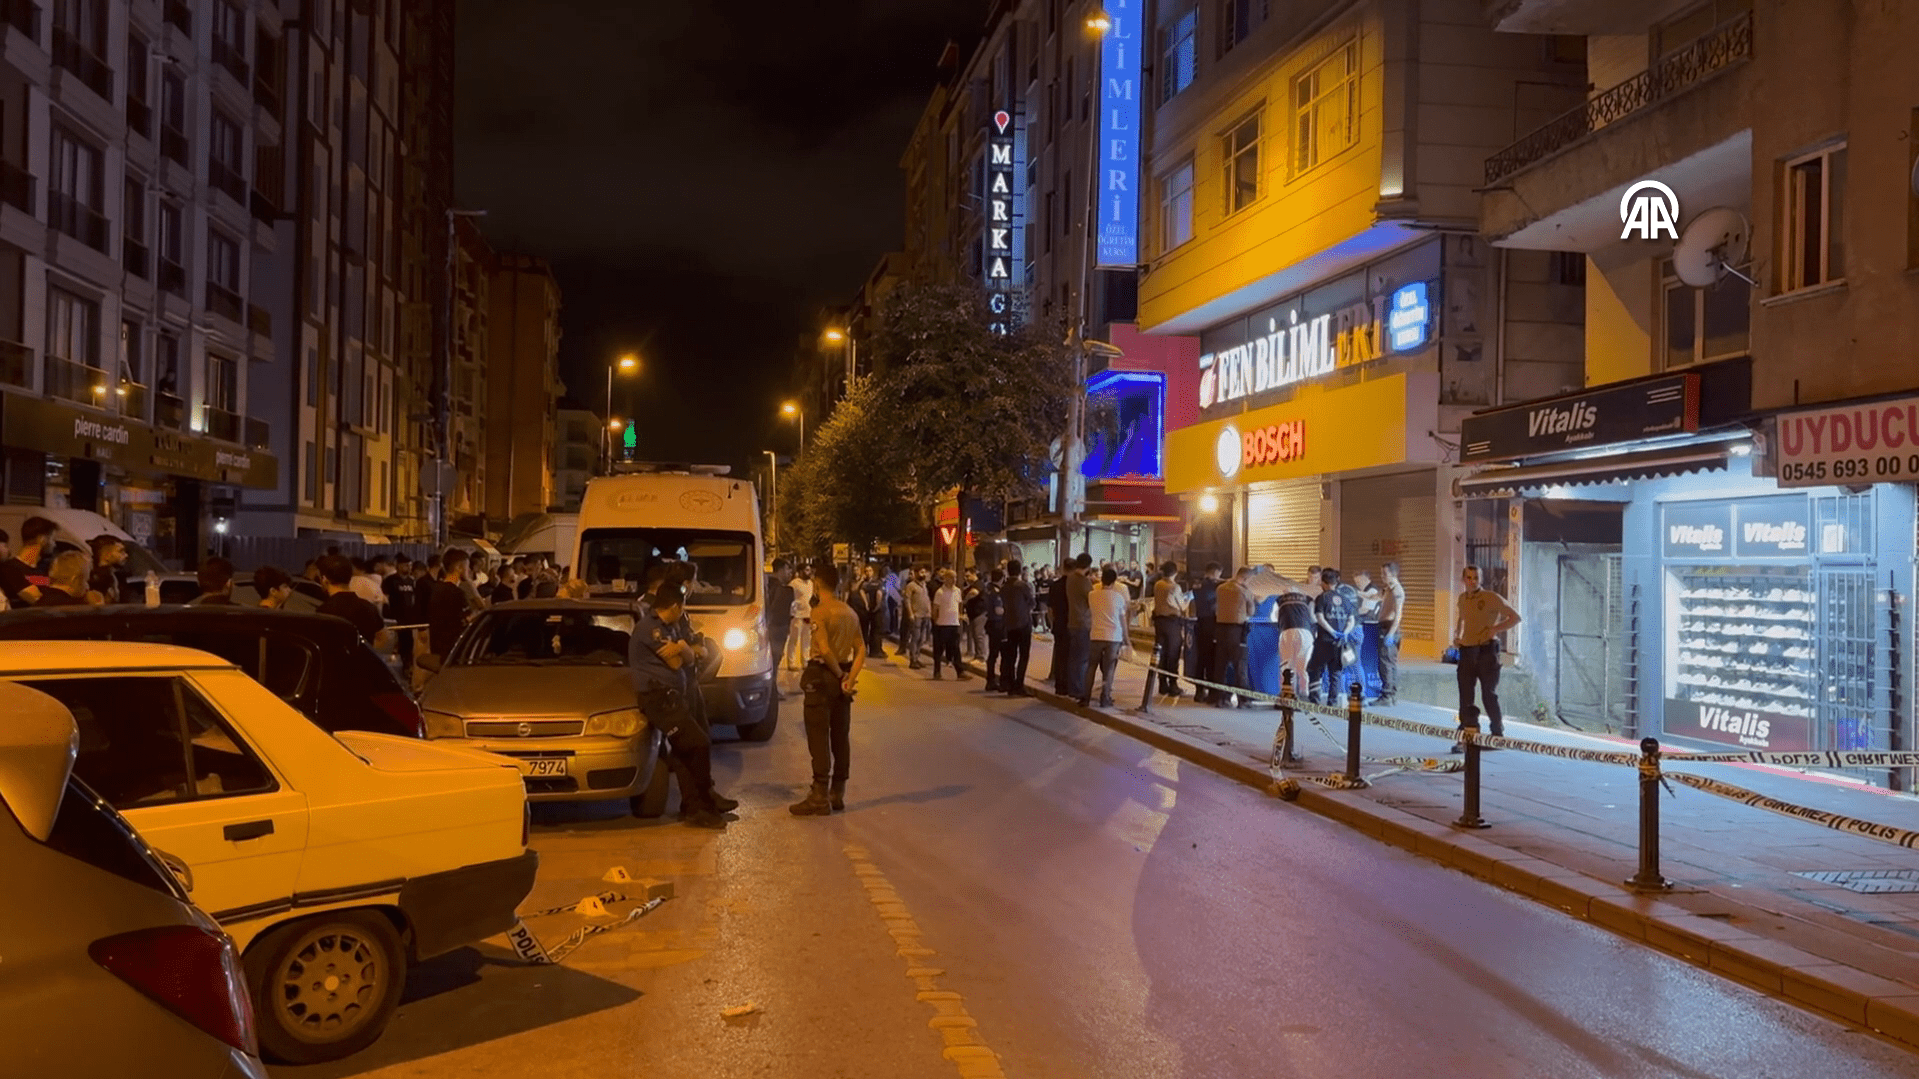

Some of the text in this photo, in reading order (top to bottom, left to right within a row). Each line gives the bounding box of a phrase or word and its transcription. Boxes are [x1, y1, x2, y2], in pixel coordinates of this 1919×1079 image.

[991, 144, 1011, 278] MARKA
[1217, 341, 1254, 403] FEN
[1254, 275, 1386, 392] BİLİMLERİ
[74, 415, 129, 445] pierre cardin
[1528, 401, 1597, 438] Vitalis
[1243, 420, 1307, 467] BOSCH
[1783, 461, 1826, 480] 0545
[1833, 458, 1868, 478] 693
[1876, 455, 1900, 476] 00
[1670, 524, 1724, 545] Vitalis
[1744, 521, 1806, 543] Vitalis
[1700, 705, 1770, 738] Vitalis
[529, 761, 565, 775] 7974
[618, 869, 626, 880] 5
